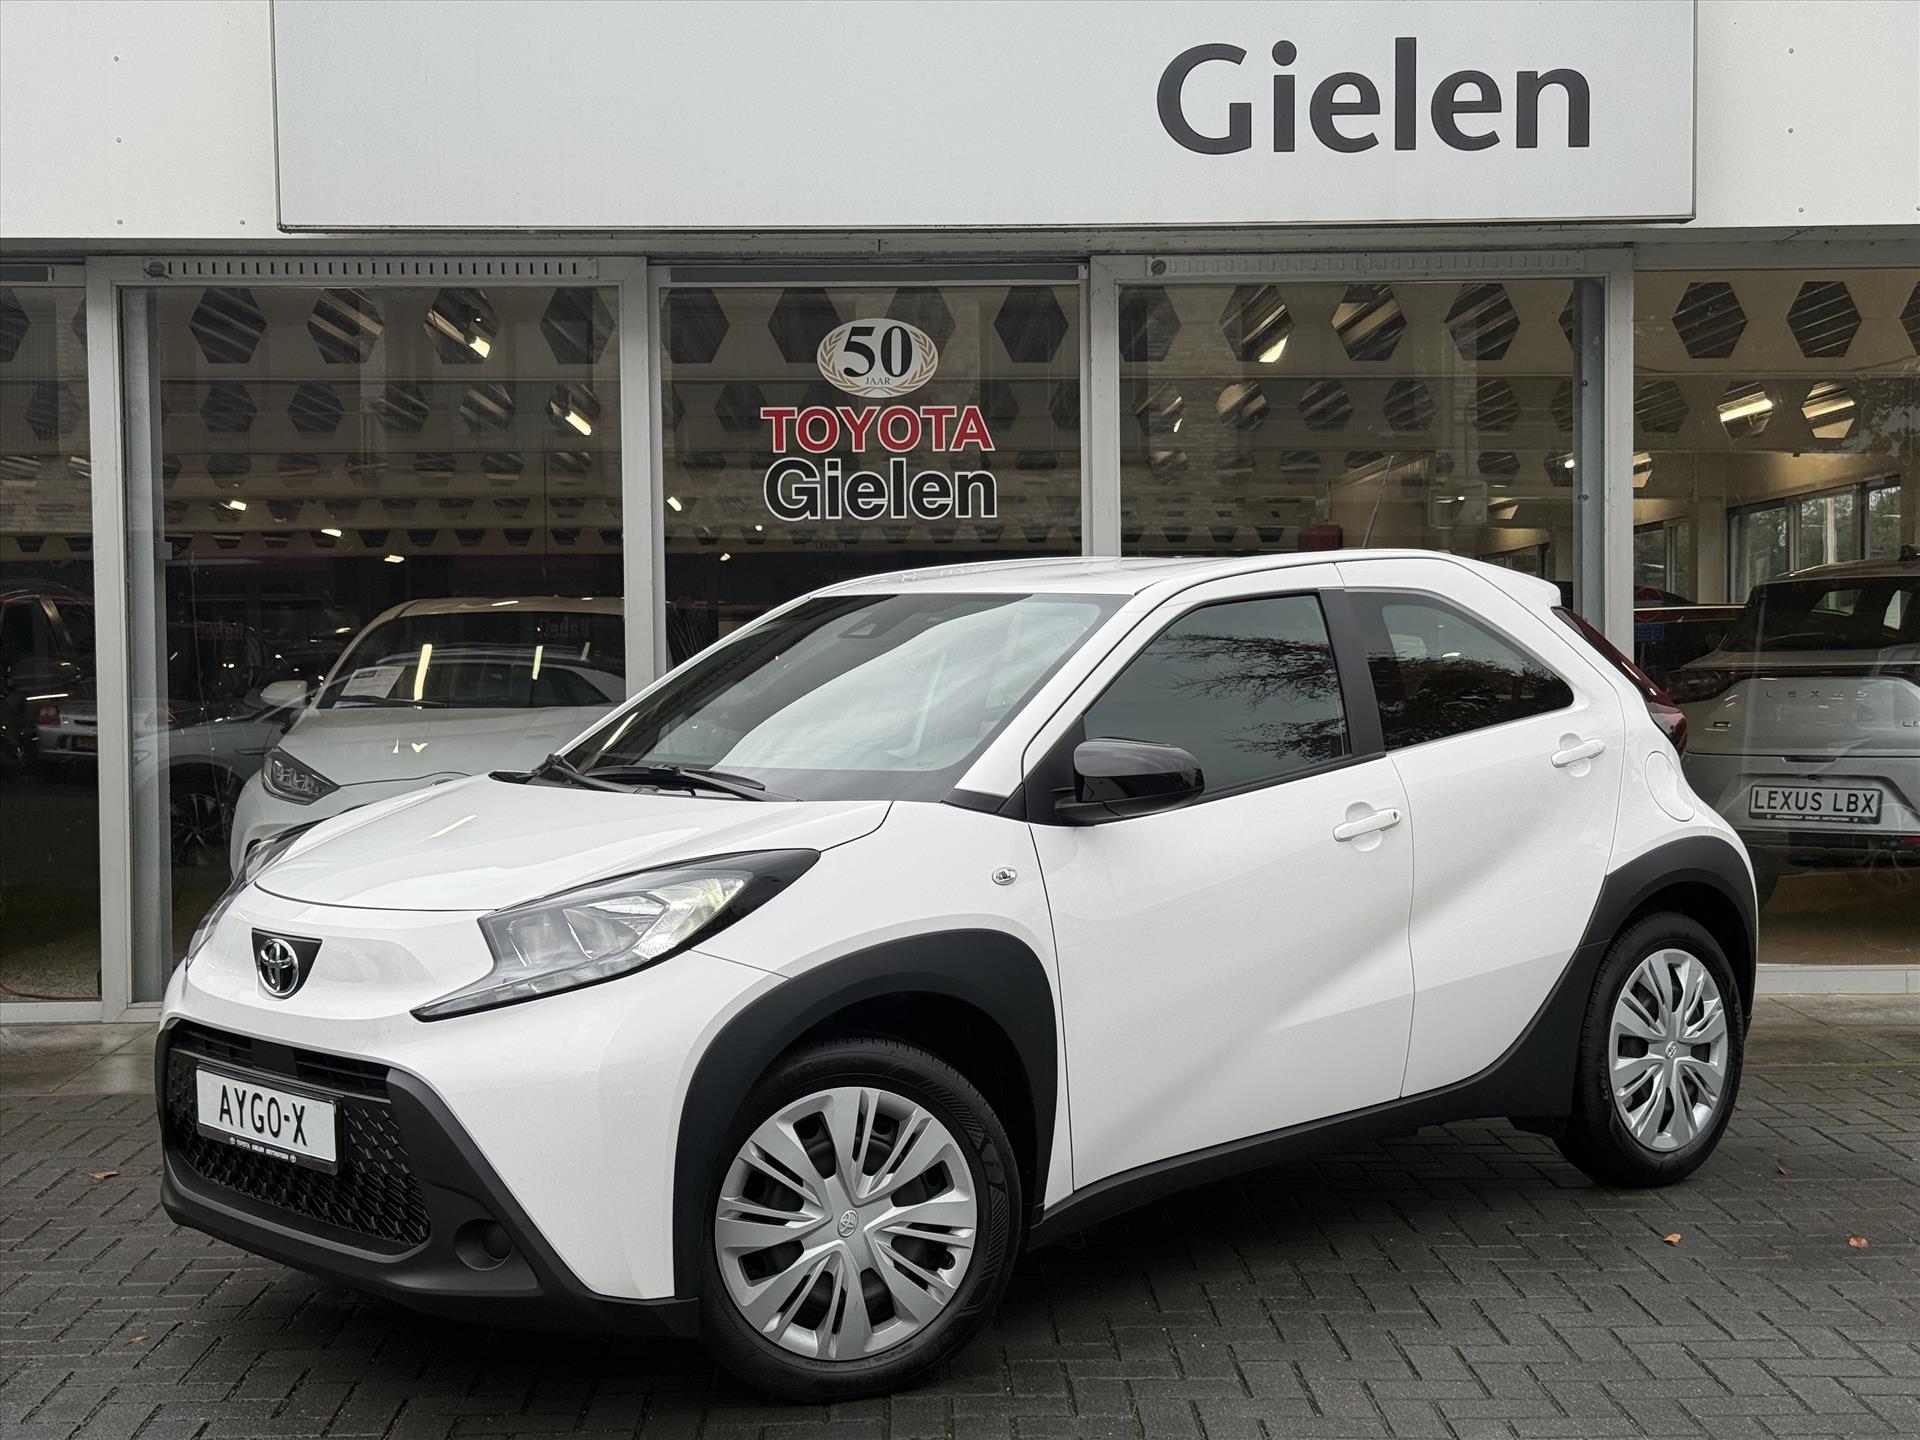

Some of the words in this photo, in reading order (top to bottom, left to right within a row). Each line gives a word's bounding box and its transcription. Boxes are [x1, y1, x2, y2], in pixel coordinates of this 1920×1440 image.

[1156, 37, 1591, 155] Gielen
[842, 325, 913, 377] 50
[864, 376, 892, 386] JAAR
[760, 405, 996, 453] TOYOTA
[763, 457, 998, 521] Gielen
[1754, 790, 1823, 811] LEXUS
[1833, 792, 1875, 813] LBX
[219, 1084, 307, 1146] AYGO-X
